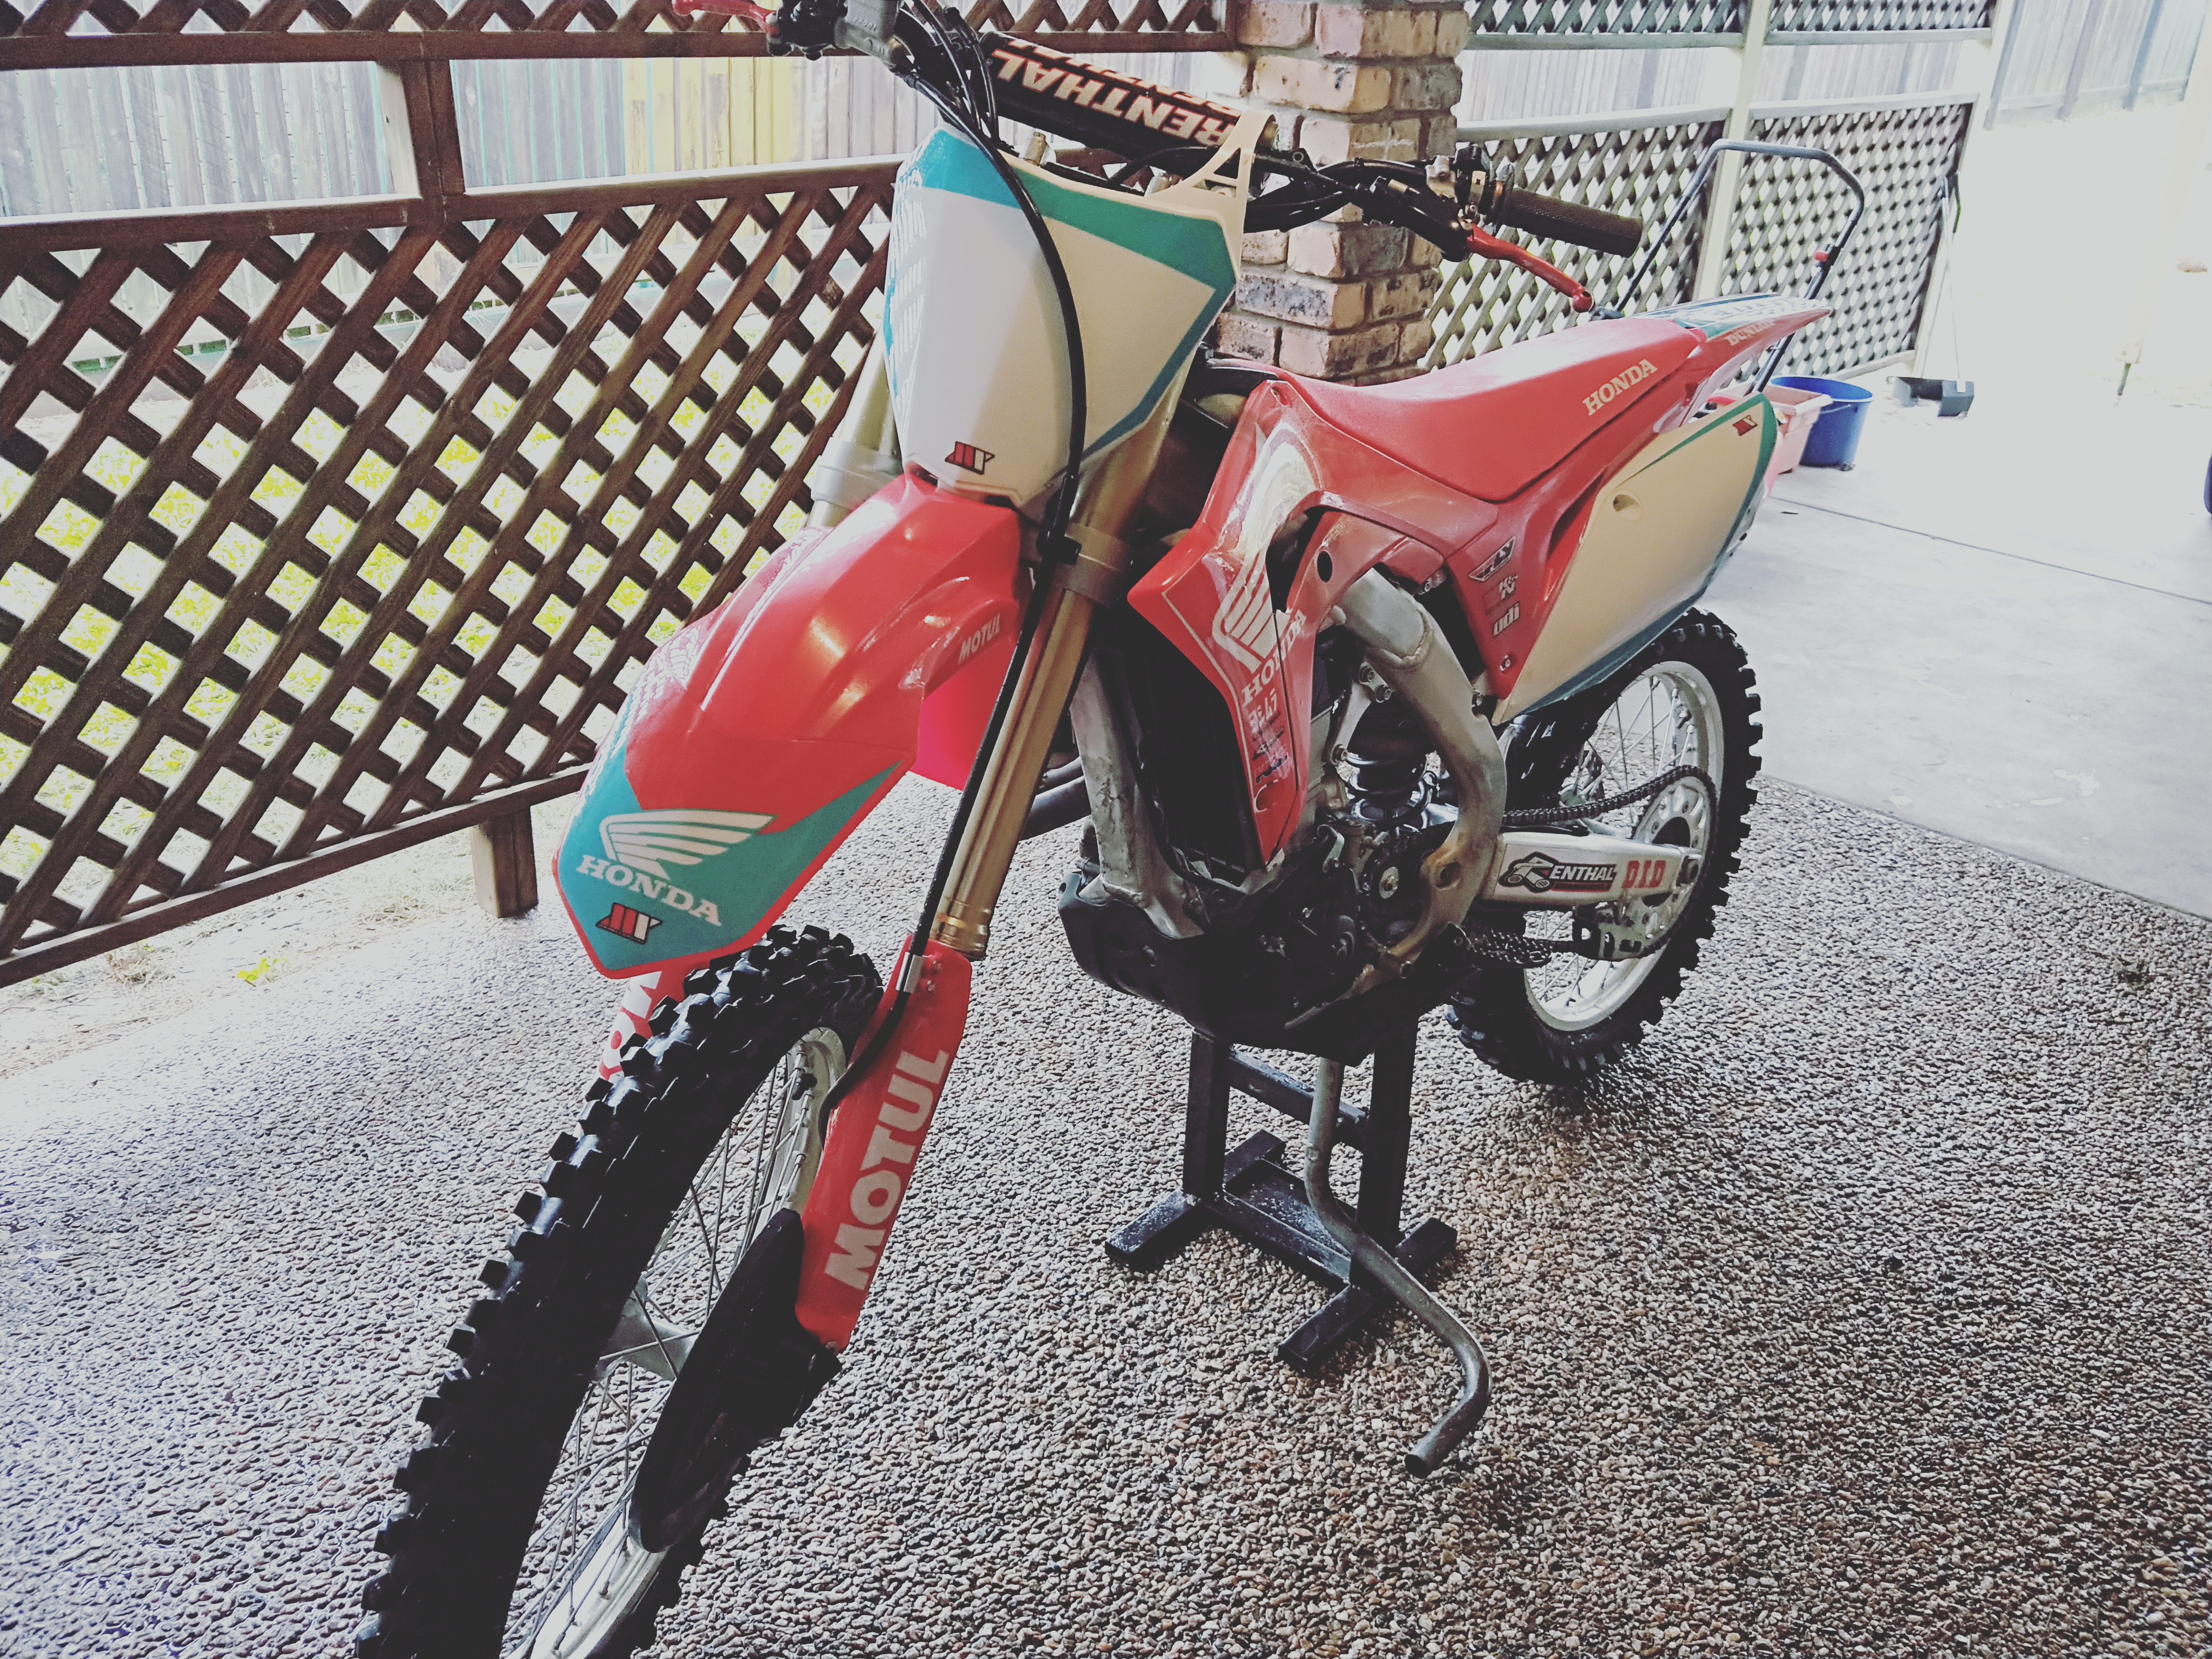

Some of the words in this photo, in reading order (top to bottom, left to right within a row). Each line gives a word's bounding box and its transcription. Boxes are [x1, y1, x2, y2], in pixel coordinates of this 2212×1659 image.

[992, 48, 1236, 145] RENTHAL
[1583, 359, 1658, 416] HONDA
[958, 613, 1000, 664] MOTUL
[1242, 609, 1307, 708] HONDA
[576, 854, 721, 926] HONDA
[825, 1050, 949, 1290] MOTUL
